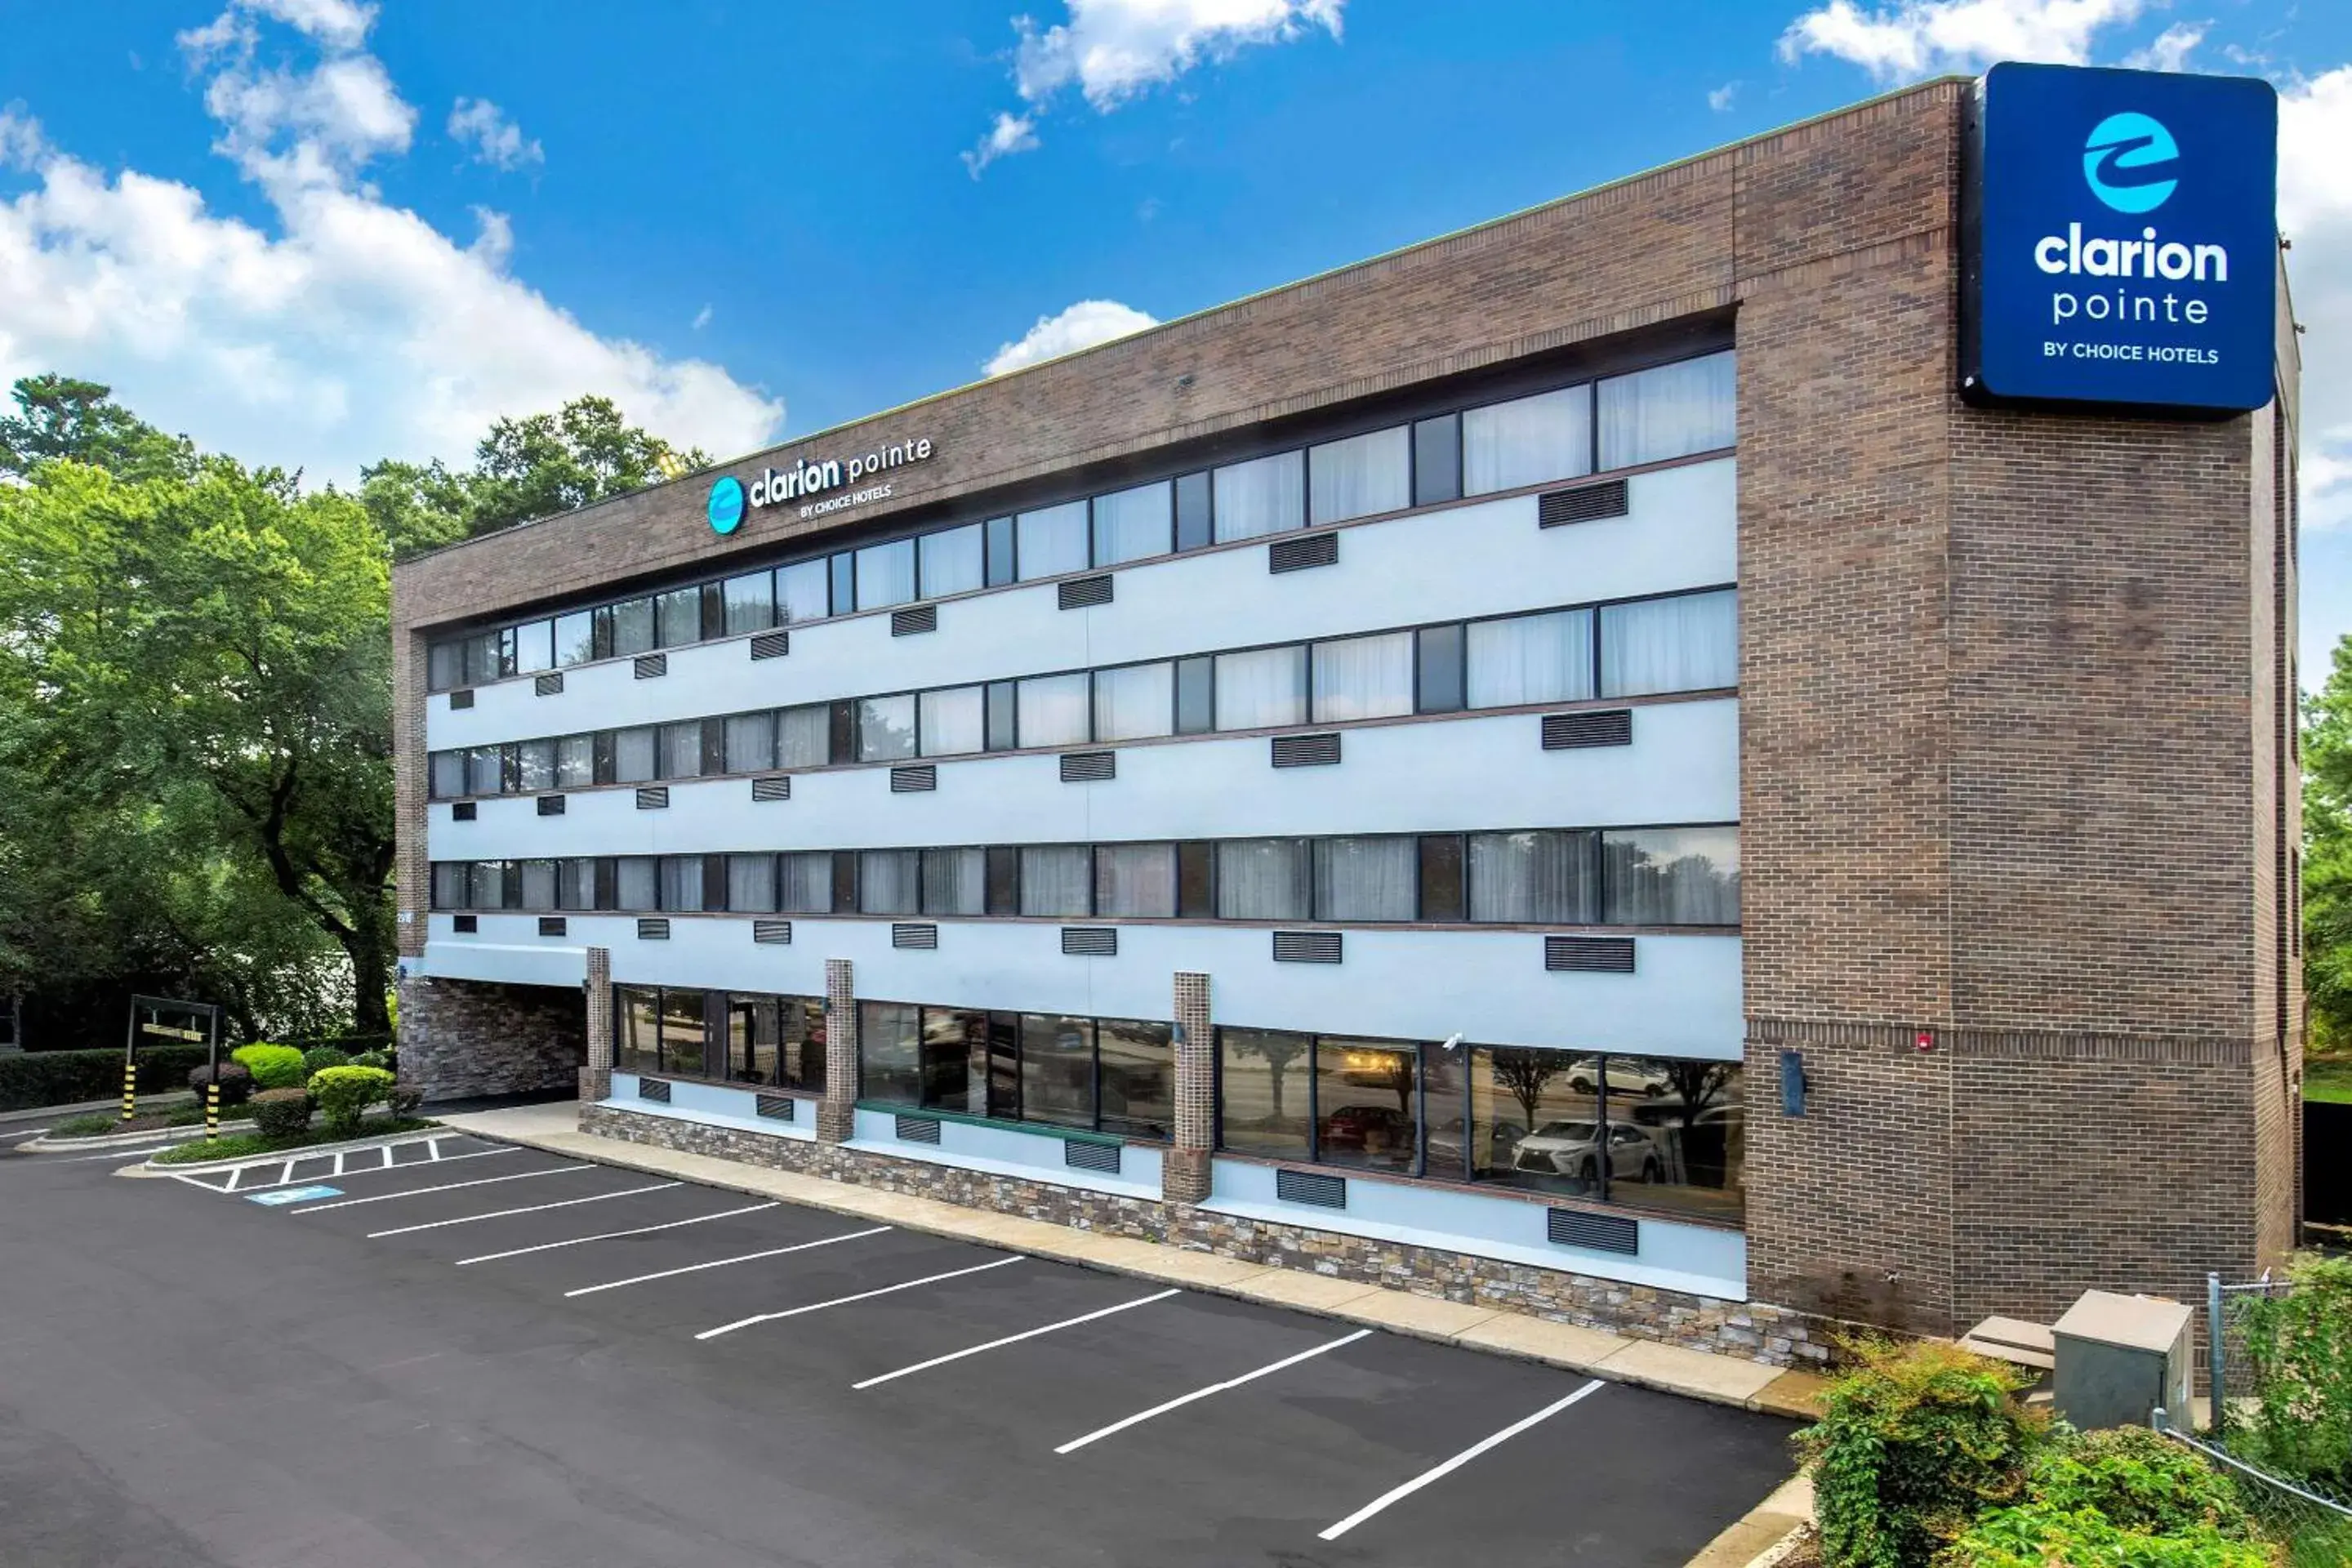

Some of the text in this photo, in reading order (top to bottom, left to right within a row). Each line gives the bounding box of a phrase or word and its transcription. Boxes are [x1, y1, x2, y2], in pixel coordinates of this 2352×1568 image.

[2034, 222, 2227, 281] clarion
[2053, 288, 2208, 325] pointe
[2044, 341, 2218, 364] BY CHOICE HOTELS
[750, 437, 932, 508] clarion pointe
[800, 484, 892, 518] BY CHOICE HOTELS
